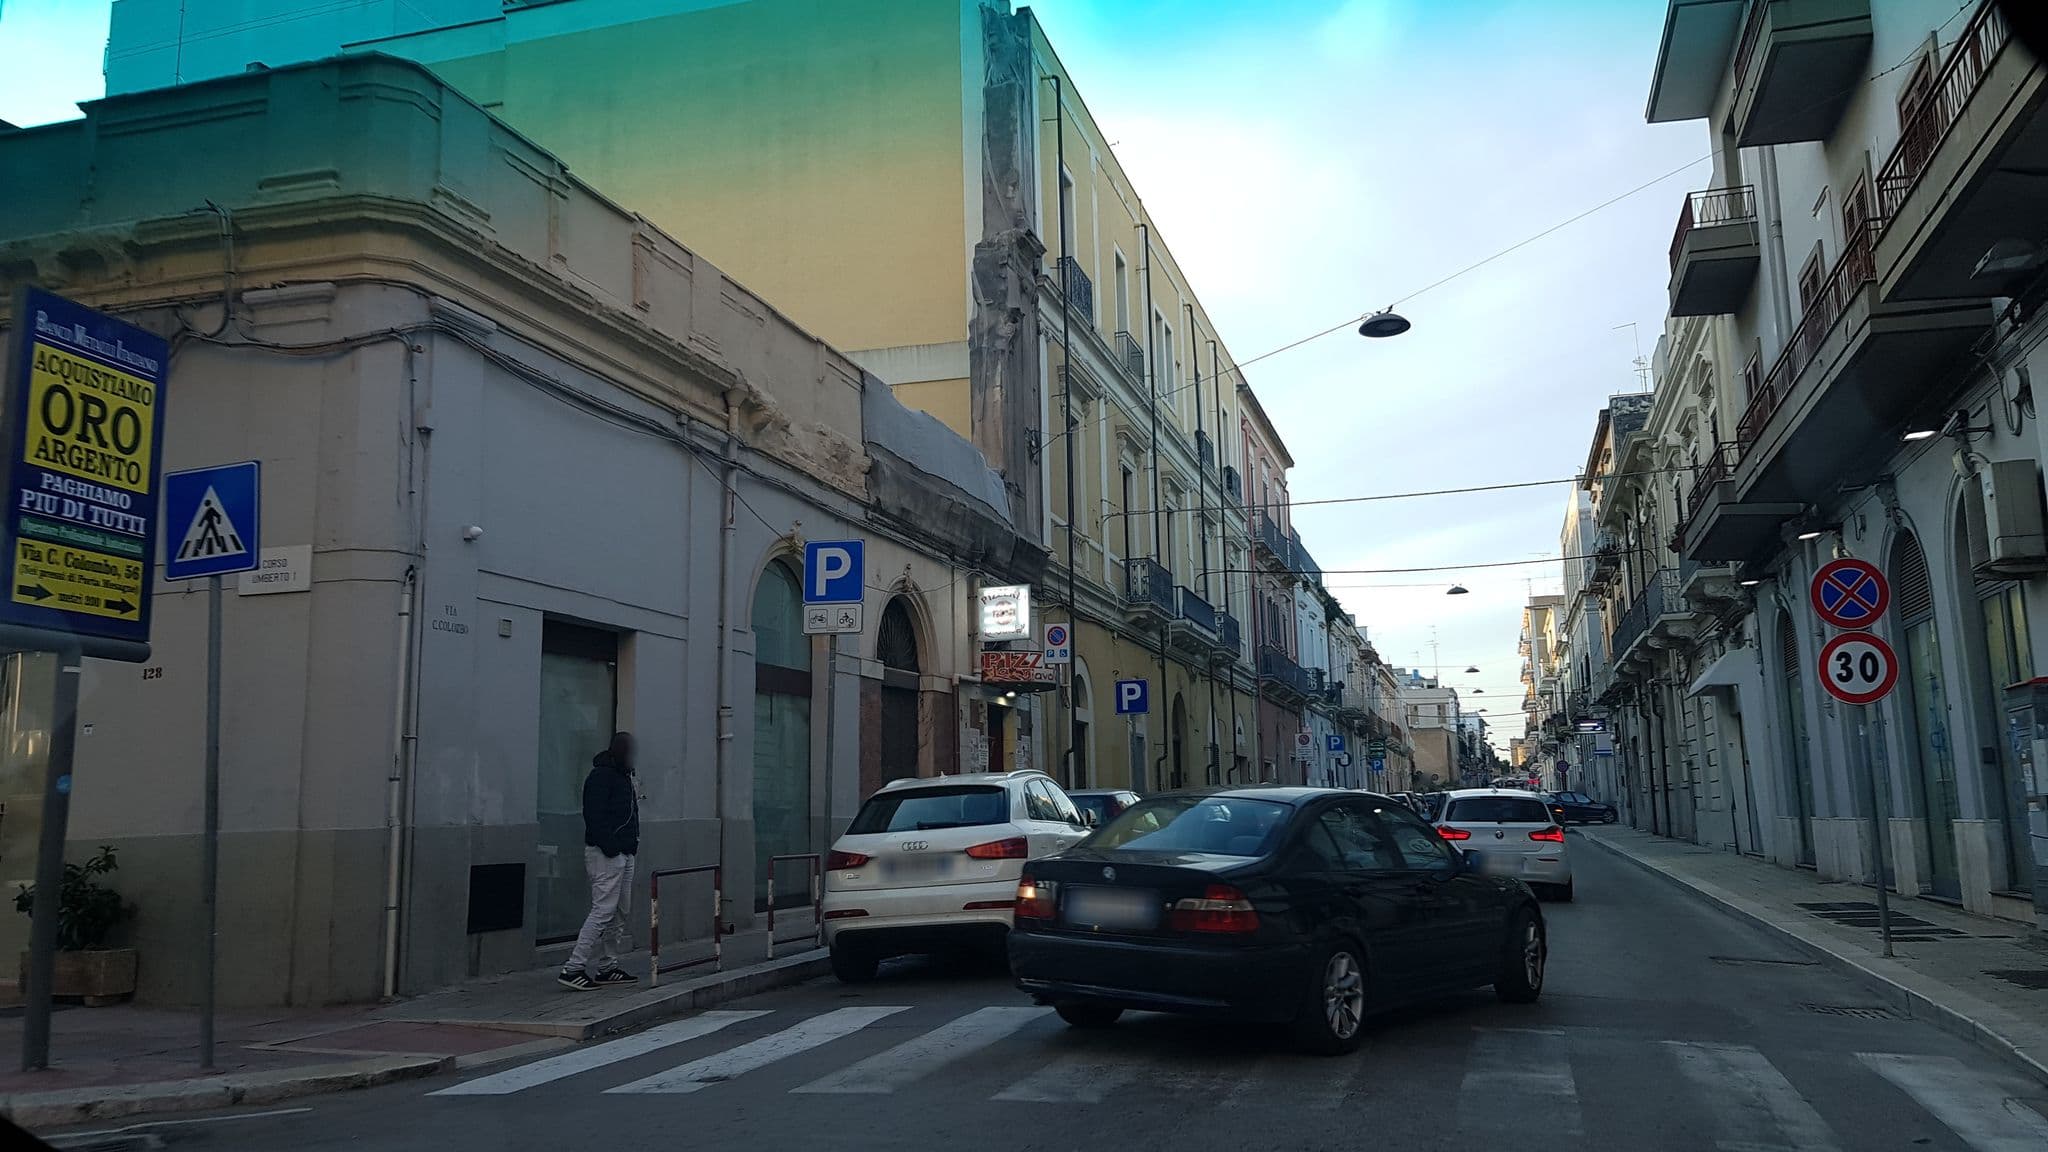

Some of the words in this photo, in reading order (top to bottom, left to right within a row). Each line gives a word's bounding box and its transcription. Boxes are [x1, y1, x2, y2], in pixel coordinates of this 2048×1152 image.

[34, 350, 153, 407] ACQUISTIAMO
[41, 383, 142, 456] ORO
[34, 435, 142, 486] ARGENTO
[40, 472, 132, 510] PAGHIAMO
[19, 488, 59, 514] PIU
[62, 498, 85, 521] DI
[89, 505, 146, 535] TUTTI
[20, 543, 42, 562] Via
[262, 558, 288, 569] CORSO
[252, 572, 290, 584] UMBERTO
[816, 547, 852, 596] P
[445, 604, 457, 617] VIA
[982, 652, 1054, 670] PIZZ
[1835, 651, 1880, 684] 30
[143, 667, 162, 681] 128
[1122, 683, 1142, 711] P
[1331, 737, 1341, 750] P
[1374, 760, 1381, 770] P
